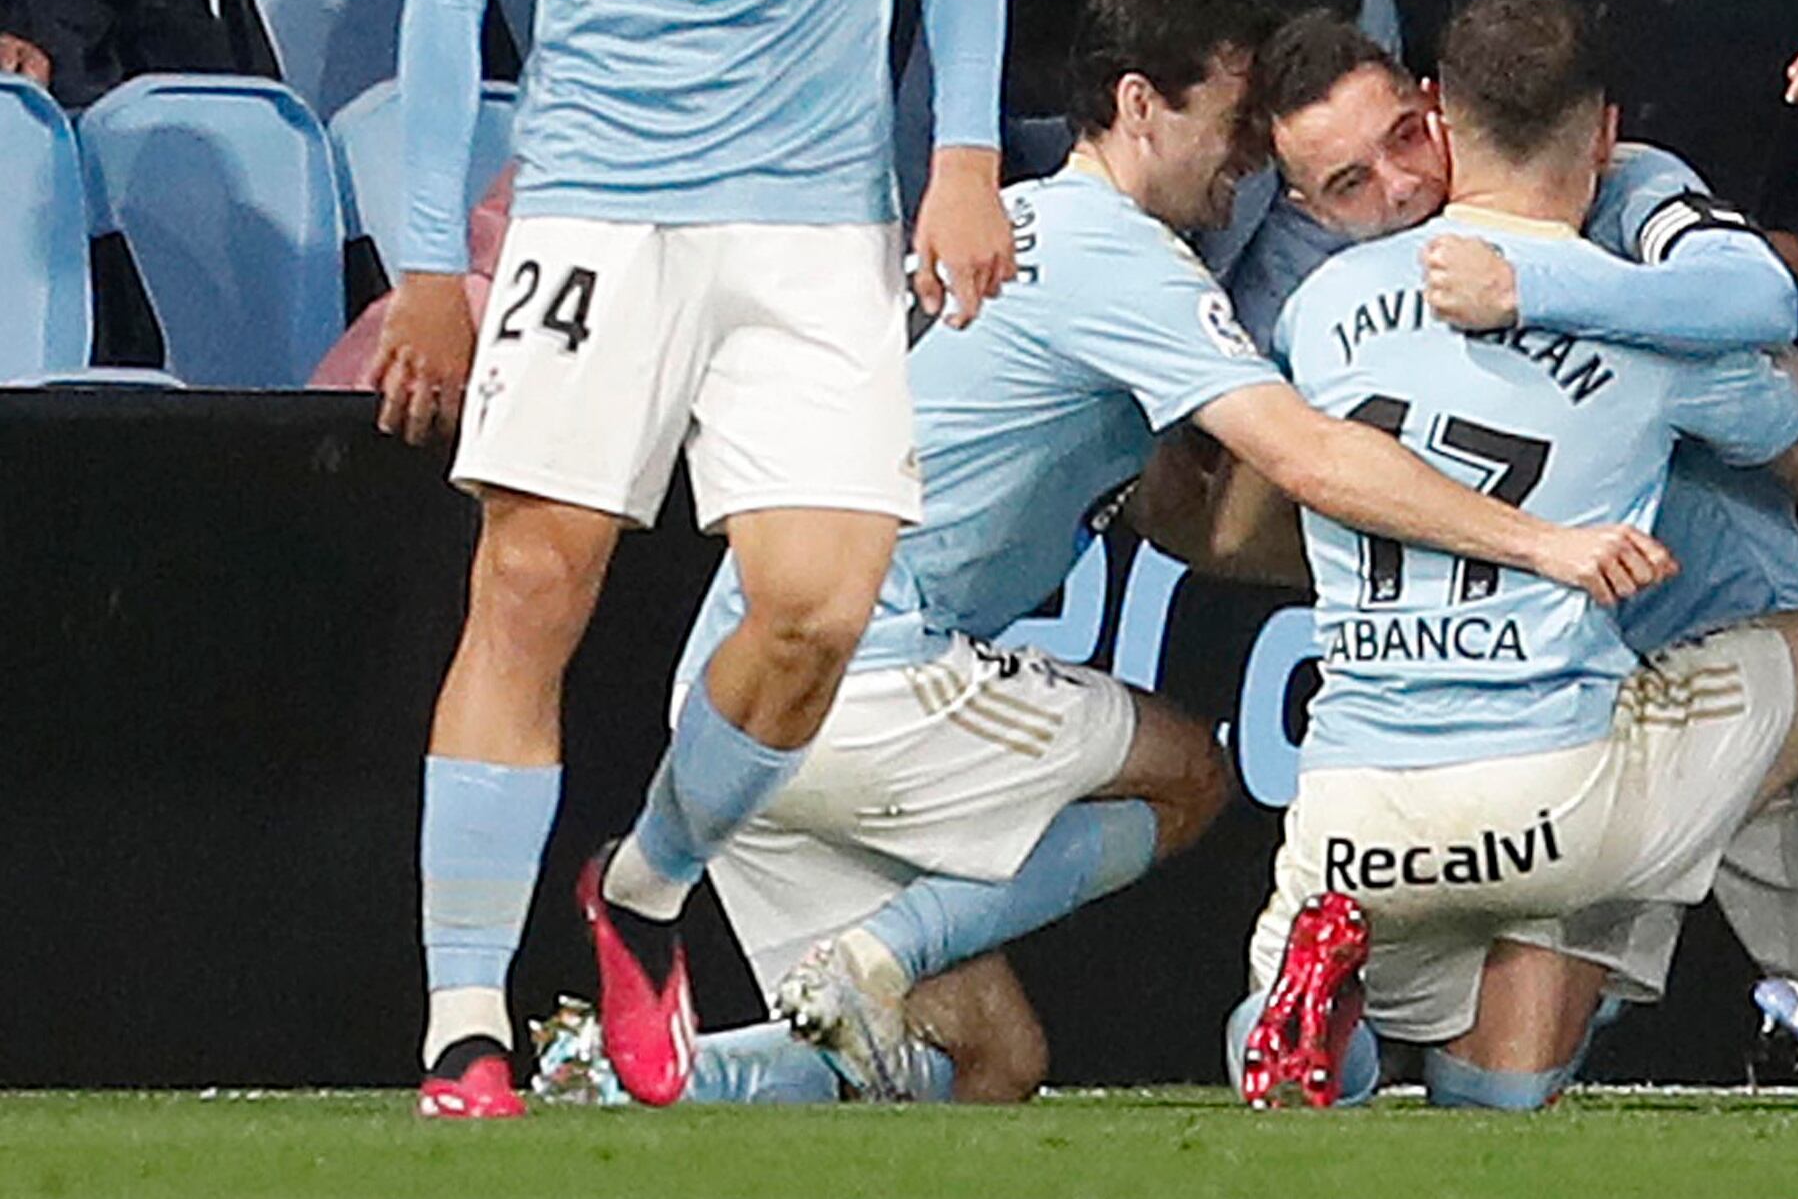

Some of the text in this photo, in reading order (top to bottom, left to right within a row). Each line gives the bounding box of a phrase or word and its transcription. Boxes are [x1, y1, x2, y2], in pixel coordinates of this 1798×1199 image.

[497, 259, 598, 353] 24
[1333, 291, 1424, 364] JAVI
[1344, 393, 1554, 612] 17
[1329, 617, 1527, 662] ABANCA
[1325, 808, 1562, 891] Recalvi
